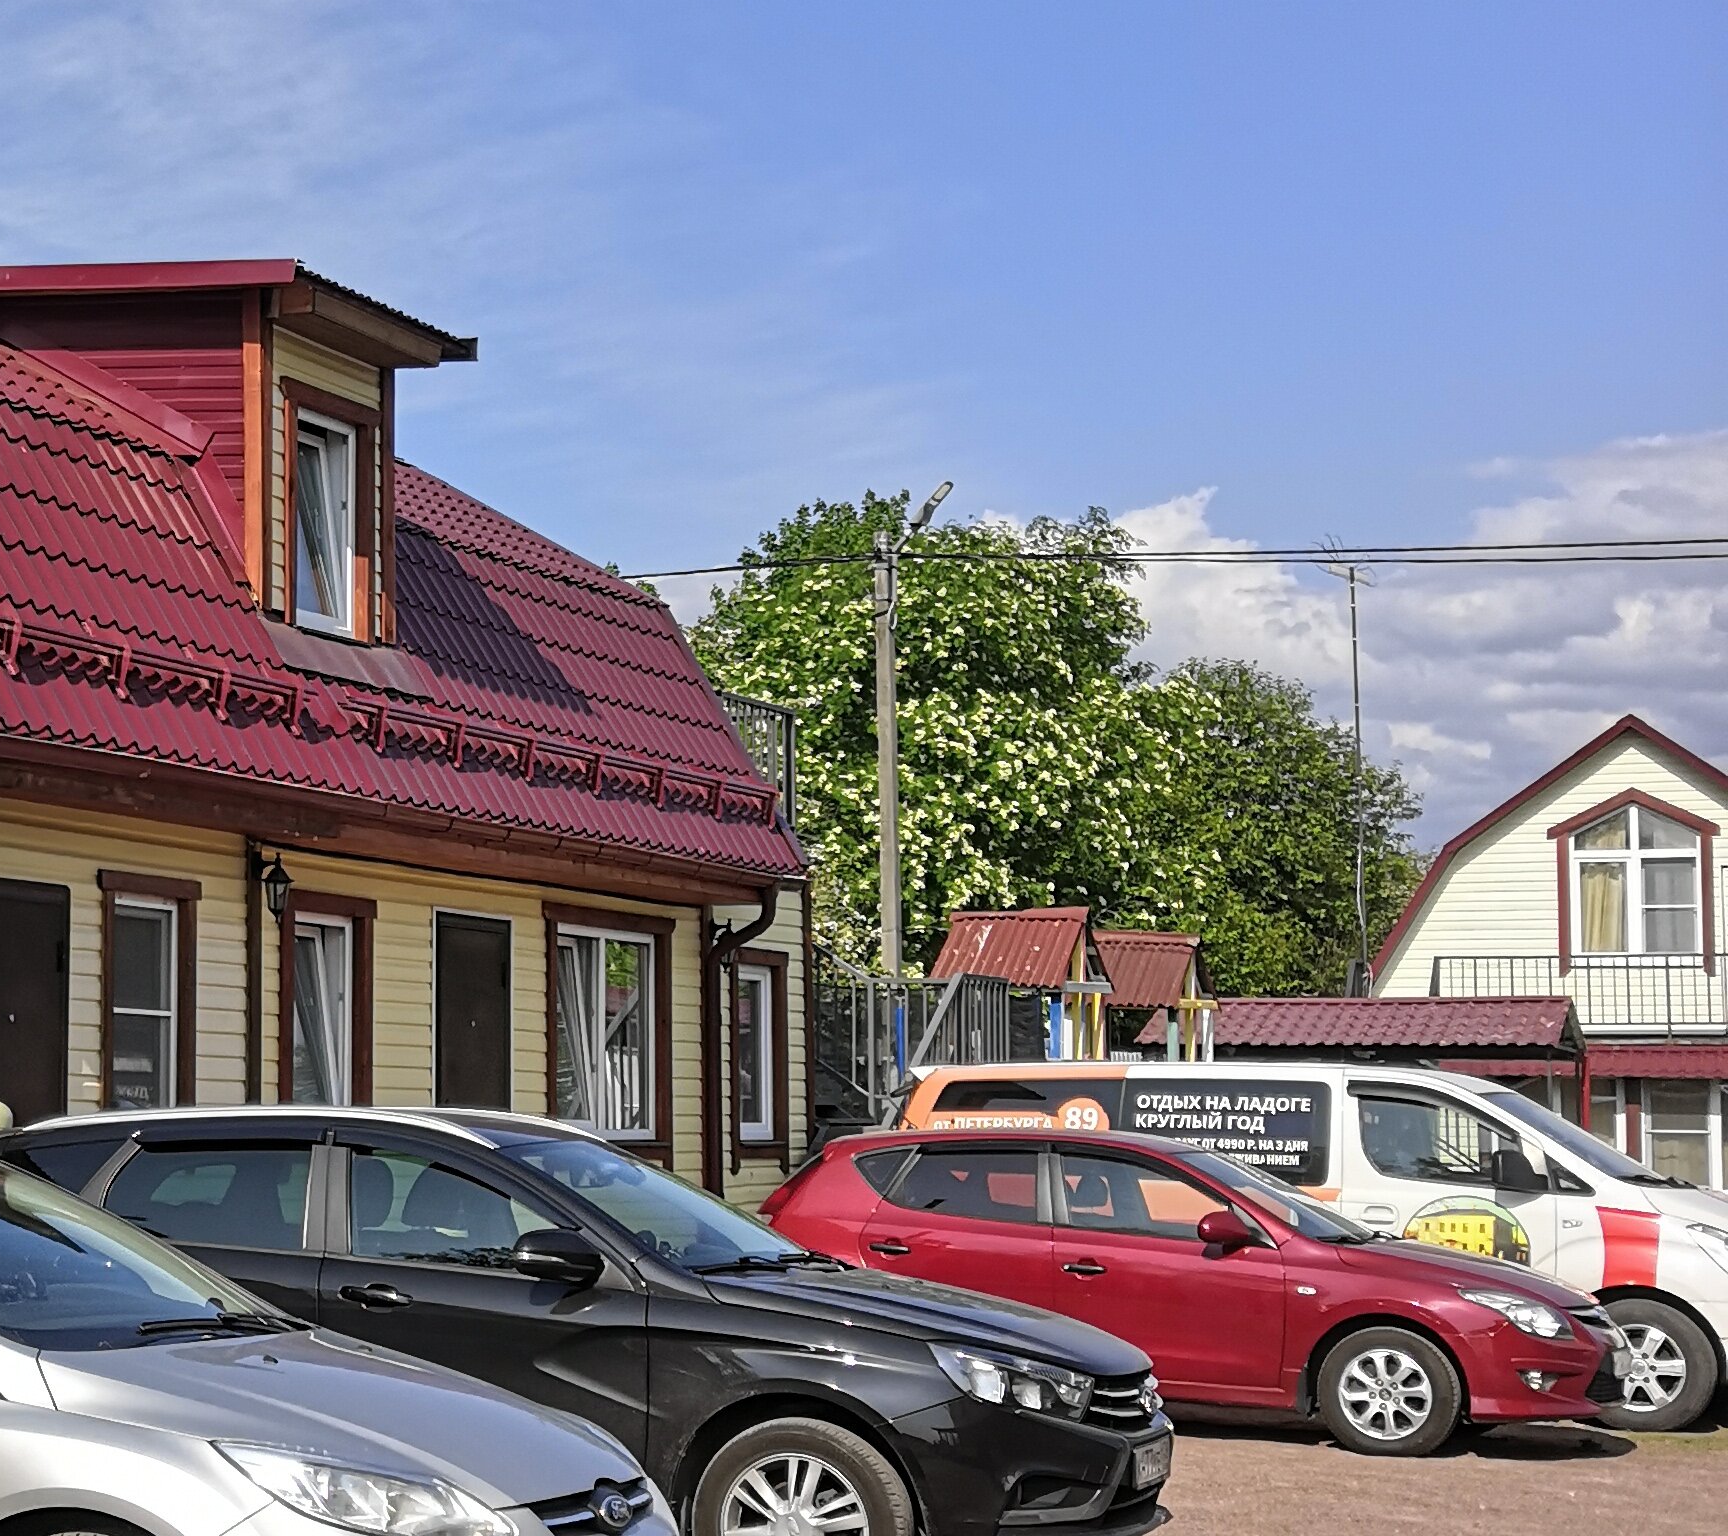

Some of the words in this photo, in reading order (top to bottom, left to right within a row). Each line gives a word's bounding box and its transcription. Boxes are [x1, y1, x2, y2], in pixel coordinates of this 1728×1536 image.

[1136, 1094, 1201, 1112] ОТДЫХ
[1205, 1095, 1231, 1111] НА
[1234, 1096, 1312, 1115] ЛАДОГЕ
[1064, 1107, 1099, 1131] 89
[1135, 1111, 1222, 1130] КРУГЛЫЙ
[1227, 1115, 1265, 1134] ГОД
[1217, 1138, 1245, 1151] 4990
[1259, 1139, 1274, 1151] НА
[1275, 1140, 1284, 1151] 3
[1284, 1140, 1309, 1152] ДНЯ
